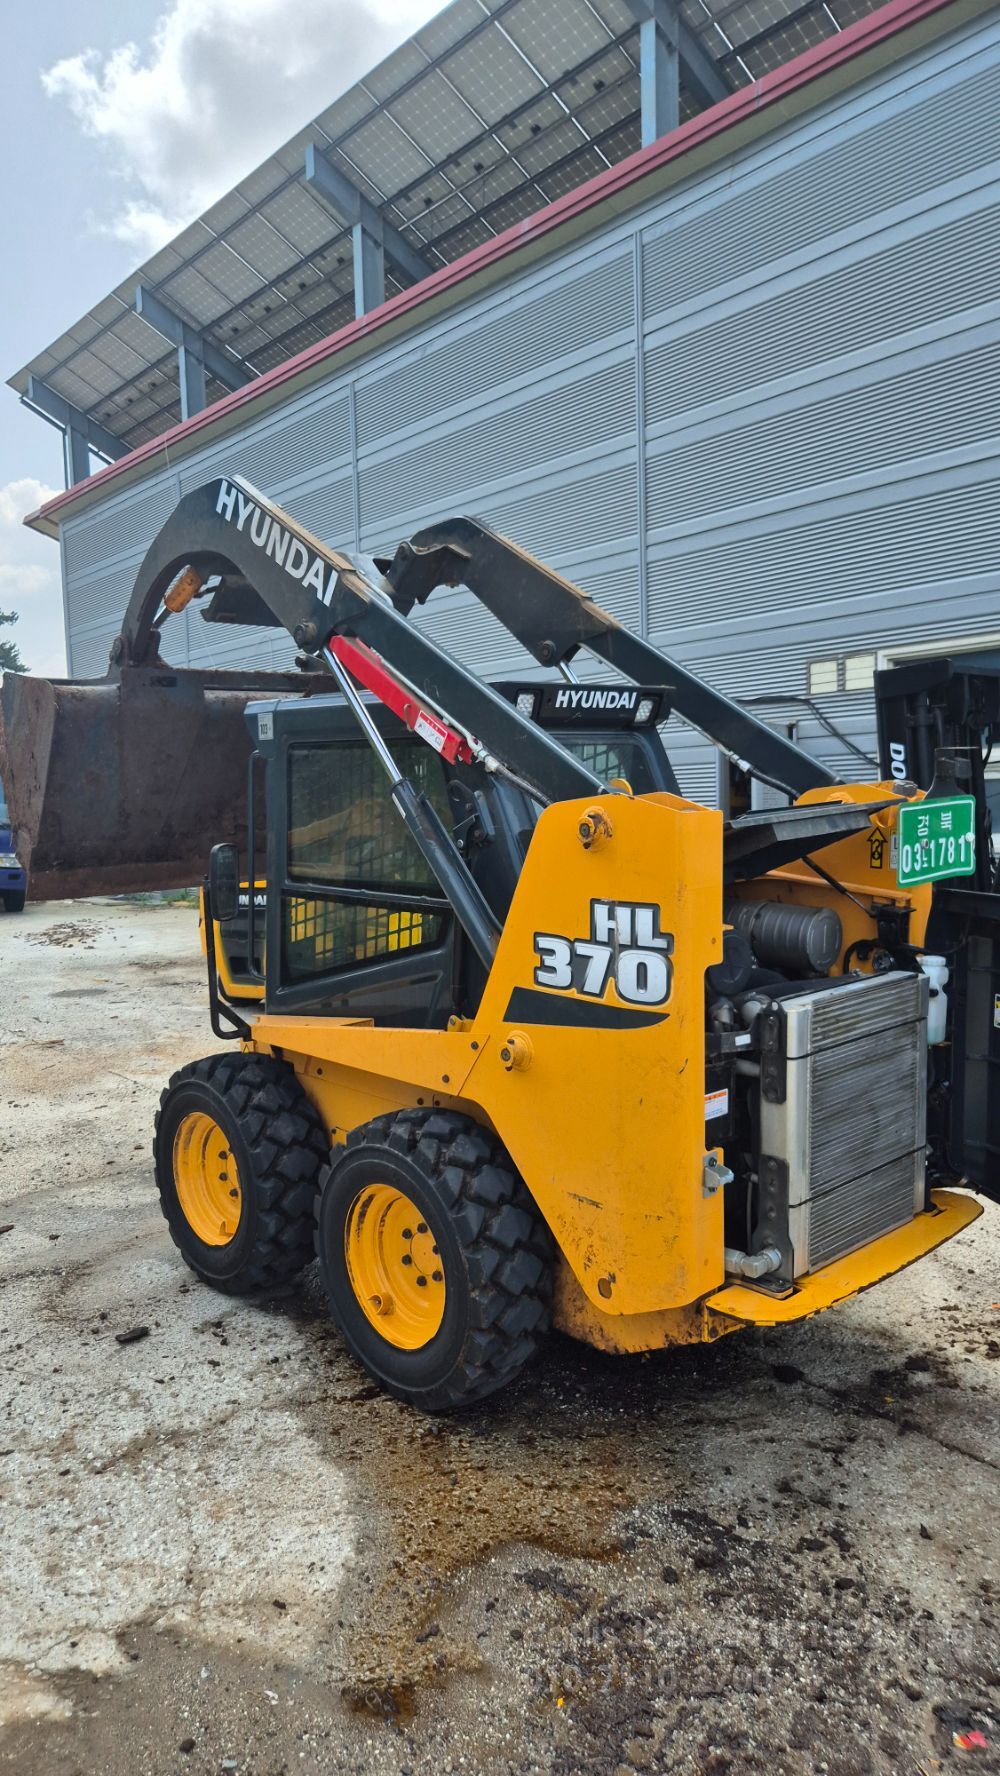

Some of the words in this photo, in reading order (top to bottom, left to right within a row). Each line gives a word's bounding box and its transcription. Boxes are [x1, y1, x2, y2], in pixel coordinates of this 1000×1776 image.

[216, 480, 339, 607] HYUNDAI
[555, 690, 637, 709] HYUNDAI
[592, 901, 671, 950] HL
[535, 934, 670, 1004] 370
